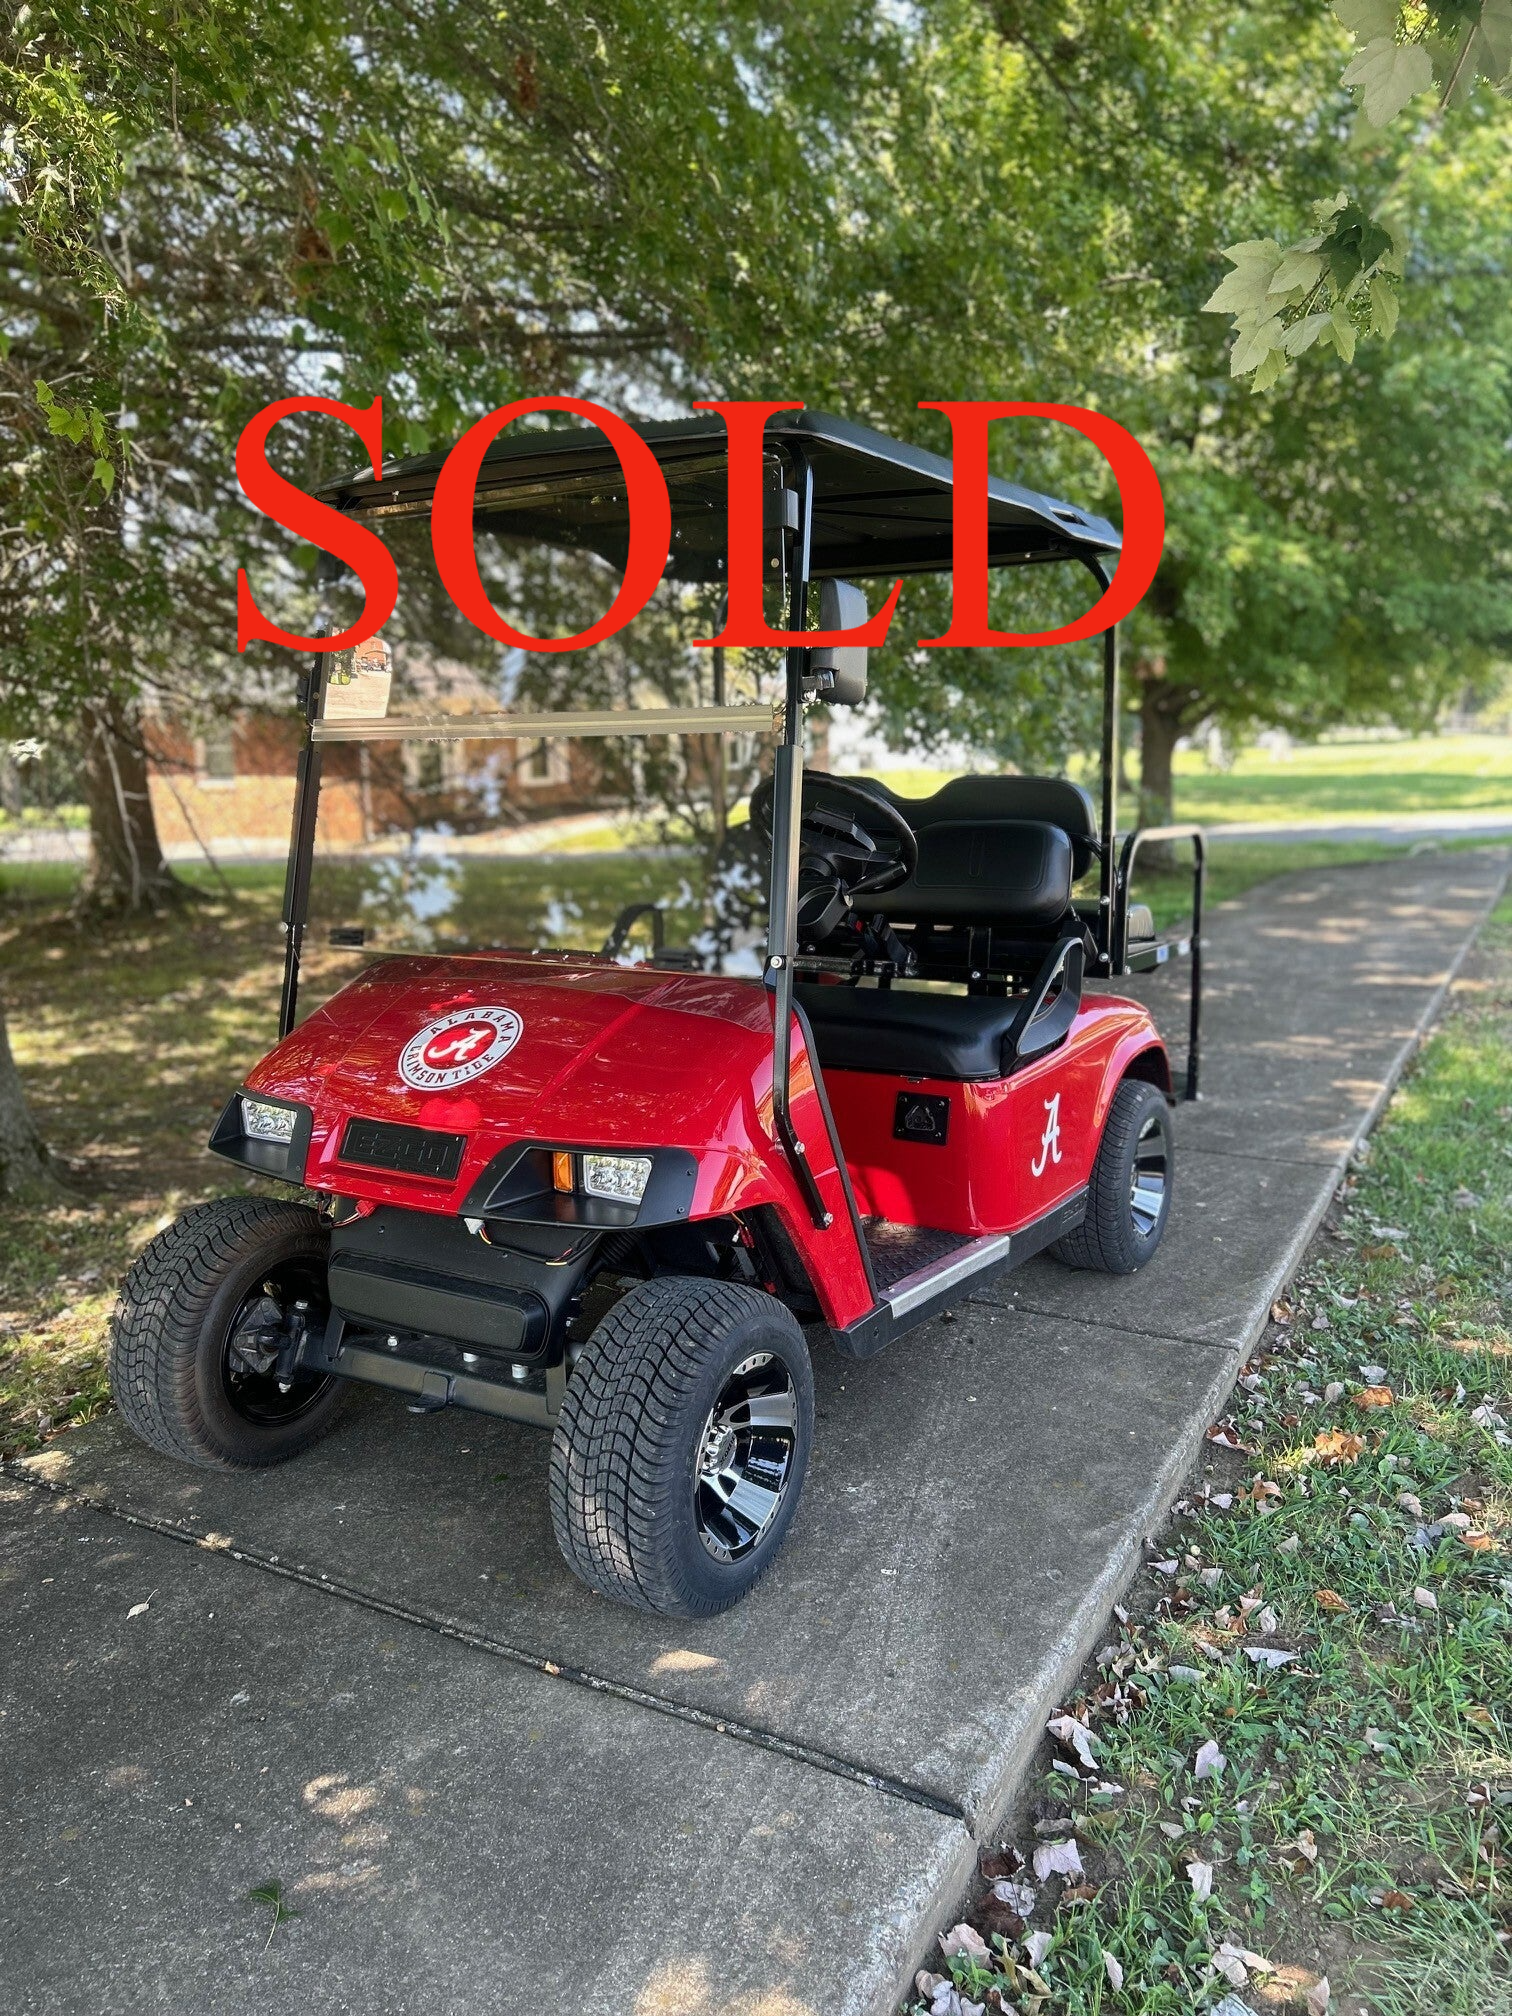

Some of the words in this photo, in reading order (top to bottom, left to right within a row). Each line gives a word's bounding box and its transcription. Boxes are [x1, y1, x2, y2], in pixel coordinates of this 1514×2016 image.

[430, 1010, 515, 1045] ALABAMA
[406, 1044, 447, 1085] CRIMSON
[451, 1053, 495, 1081] TIDE
[1031, 1092, 1062, 1178] A
